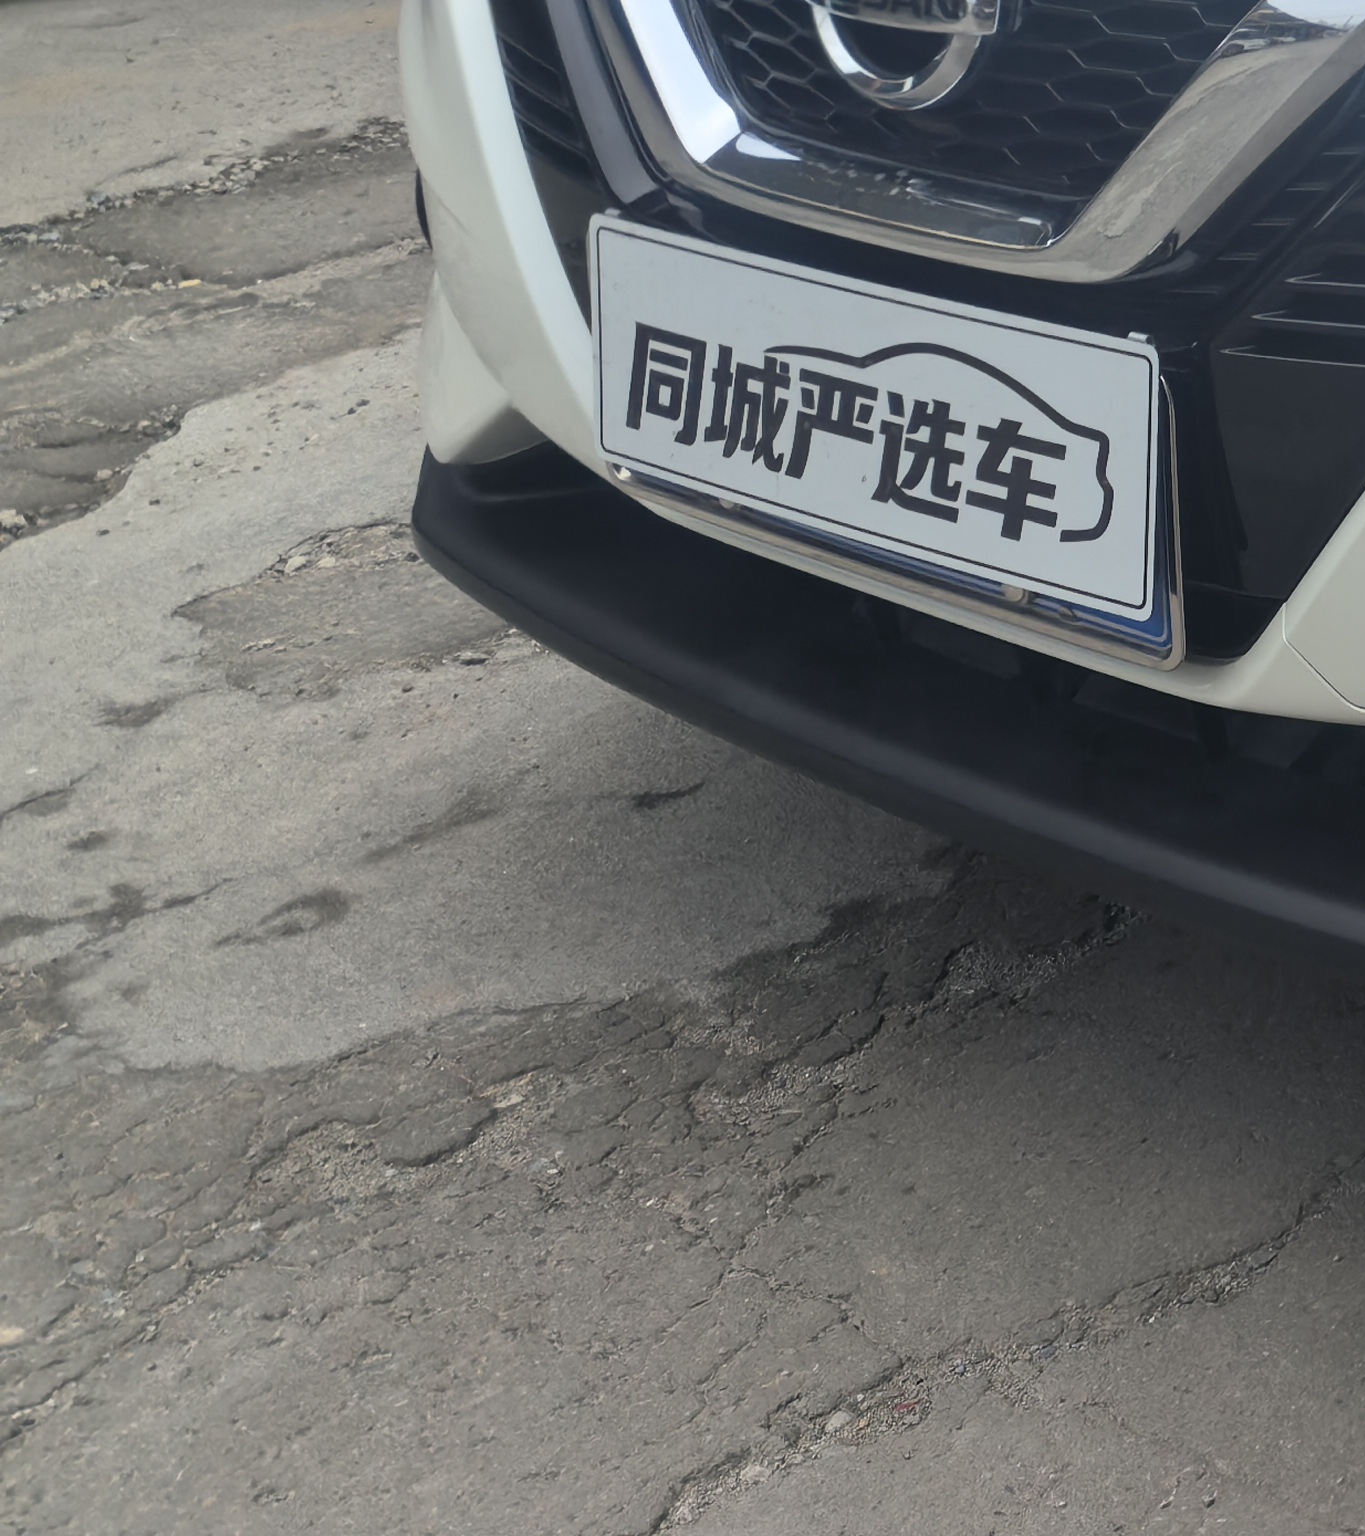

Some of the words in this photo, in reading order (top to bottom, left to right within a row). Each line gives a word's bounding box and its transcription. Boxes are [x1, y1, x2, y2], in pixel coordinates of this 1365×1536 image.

[626, 321, 1067, 541] 同城严选车
